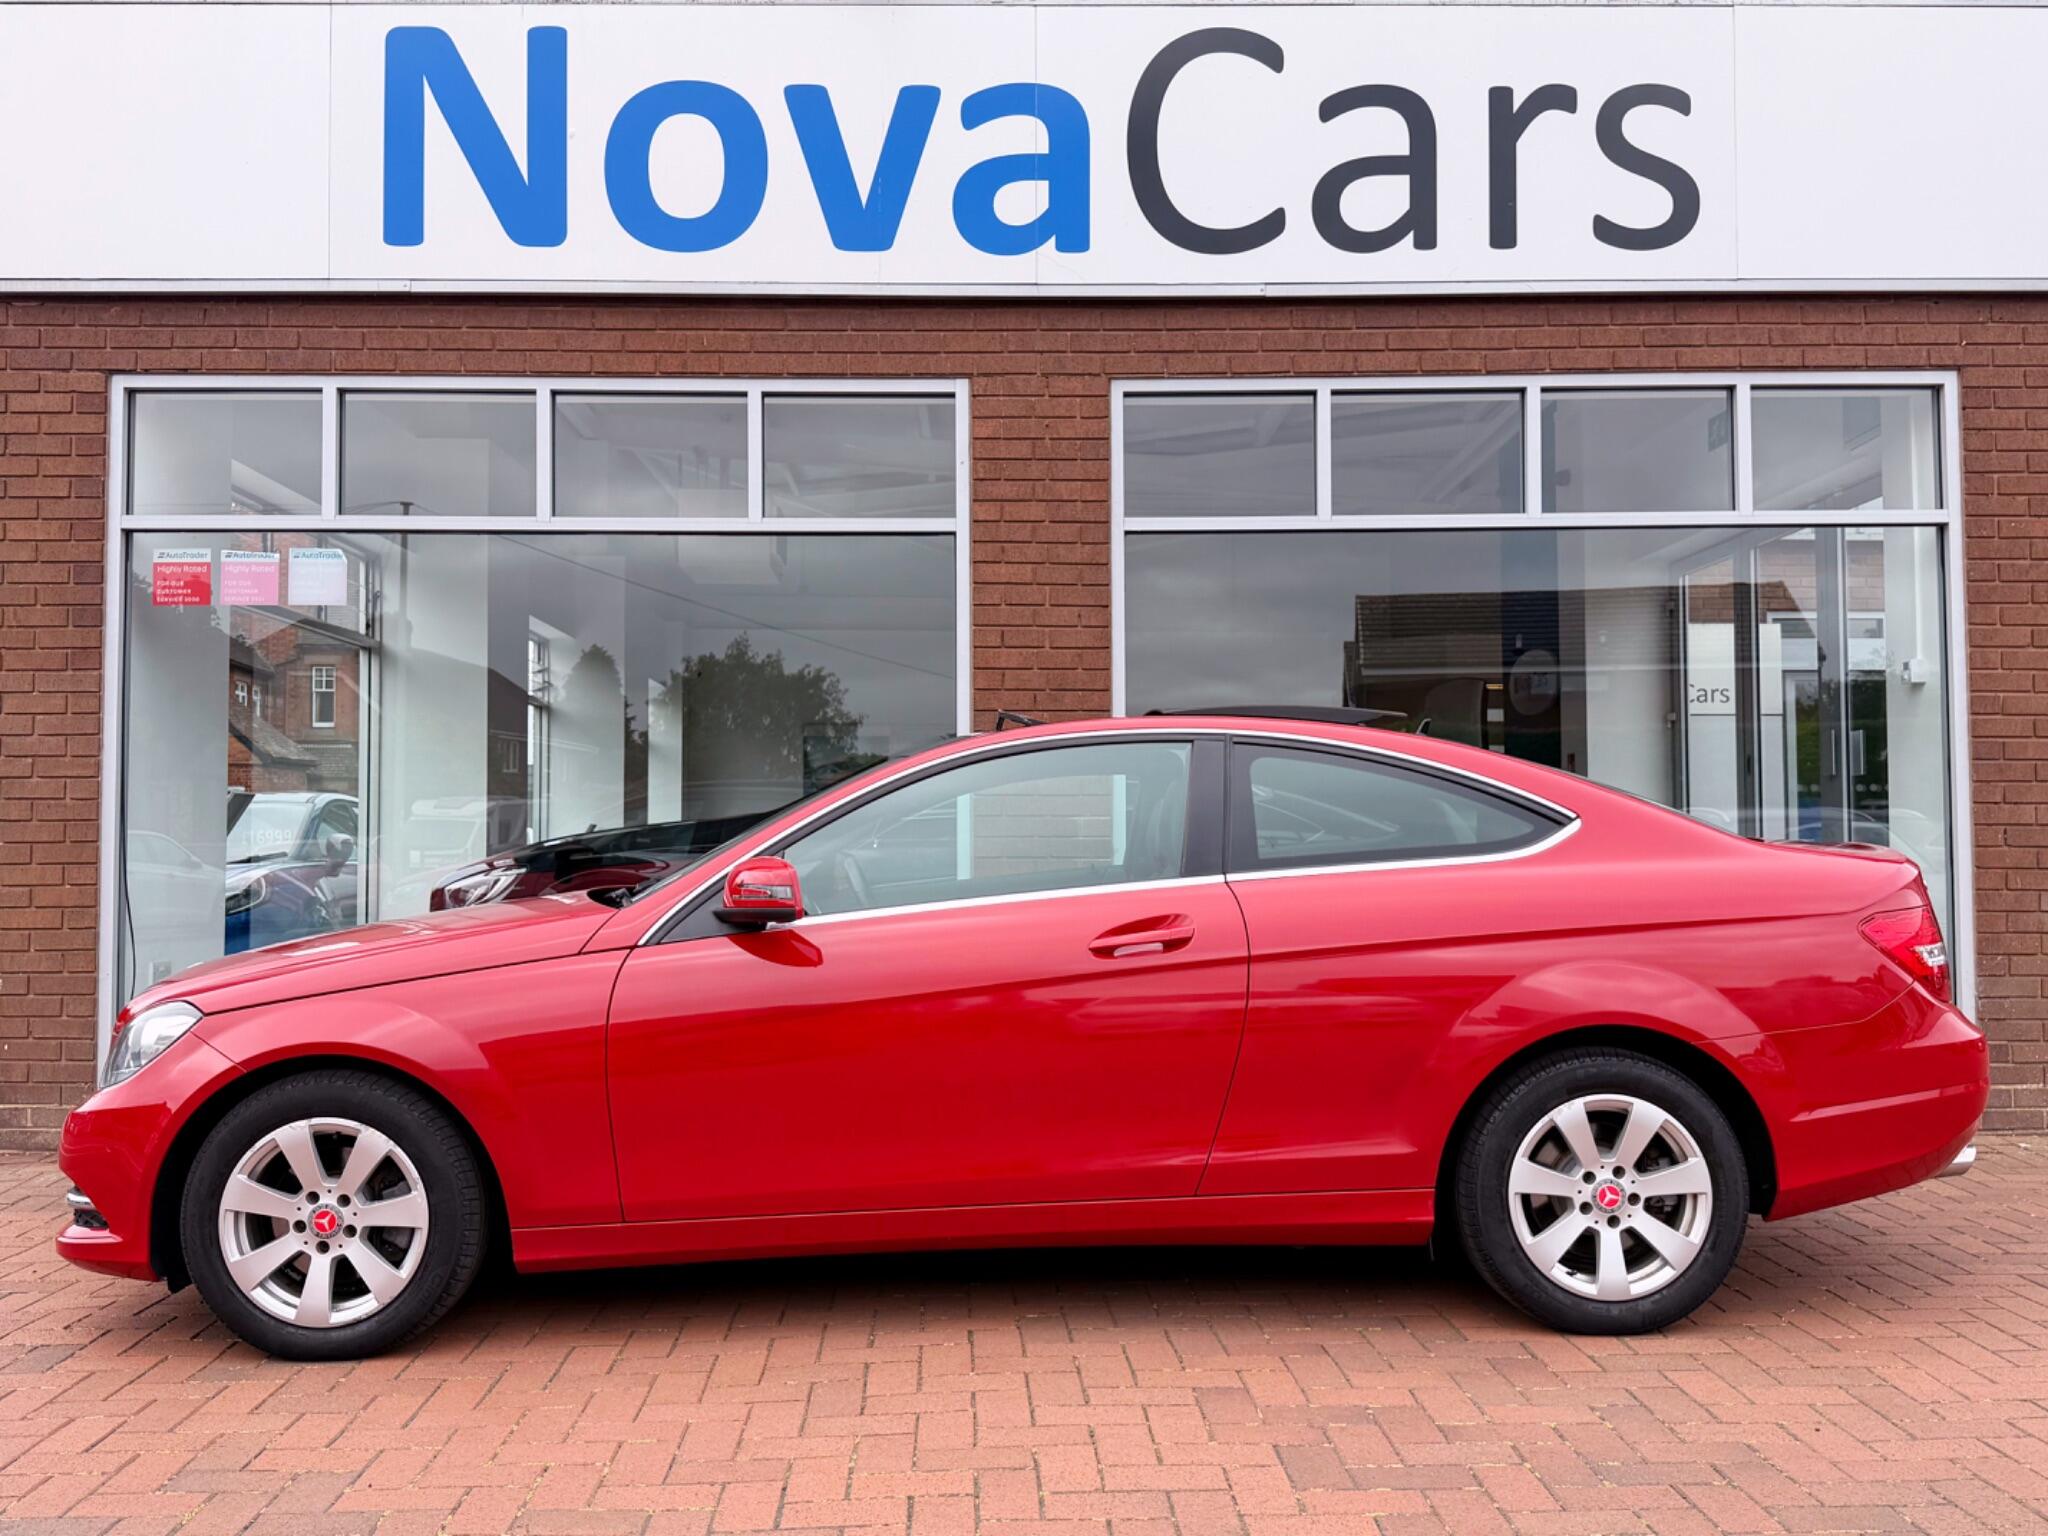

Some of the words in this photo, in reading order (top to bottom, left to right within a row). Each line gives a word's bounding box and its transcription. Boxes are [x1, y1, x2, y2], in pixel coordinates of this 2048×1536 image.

[383, 26, 1701, 255] NovaCars
[166, 551, 208, 559] AutoTrader
[157, 564, 182, 575] Highly
[183, 564, 208, 573] Rated
[224, 564, 250, 575] Highly
[251, 564, 275, 573] Rated
